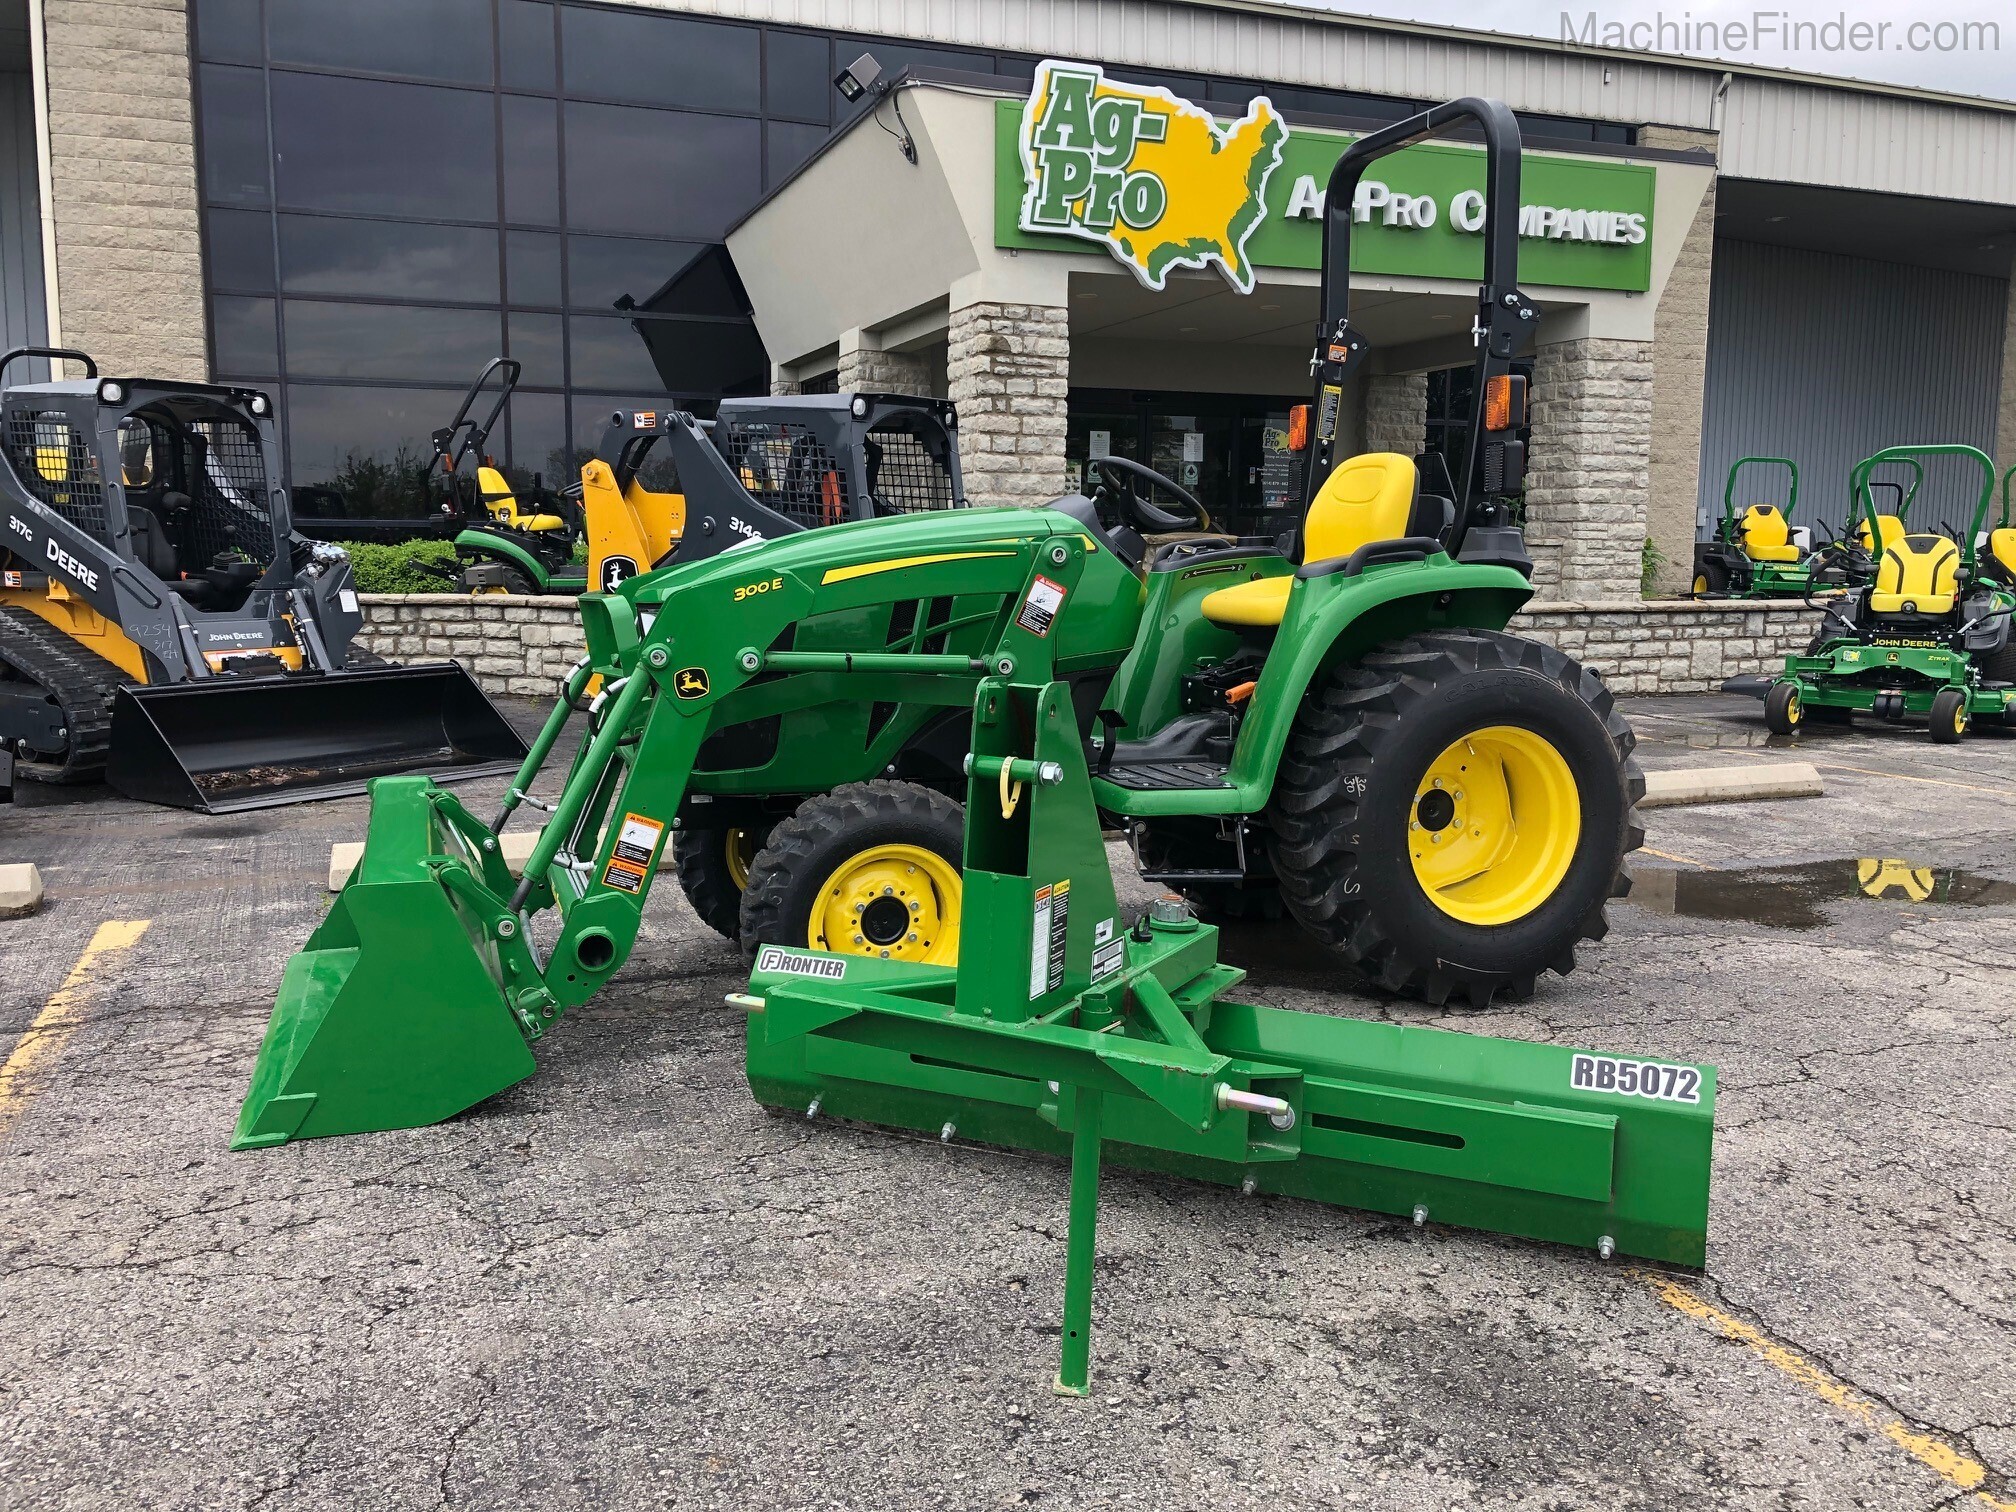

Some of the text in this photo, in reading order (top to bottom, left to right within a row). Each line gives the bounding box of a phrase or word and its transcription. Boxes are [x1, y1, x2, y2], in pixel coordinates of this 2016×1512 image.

[1034, 70, 1167, 169] Ag-
[1033, 149, 1167, 231] Pro
[1450, 189, 1646, 245] CMPANIES
[9, 515, 33, 542] 317G
[46, 537, 99, 592] DEERE
[734, 577, 783, 602] 300 E
[129, 623, 171, 638] 9254
[208, 633, 233, 641] JOHN
[1873, 638, 1937, 647] JOHN DEERE
[760, 949, 845, 977] FRONTIER
[1574, 1057, 1698, 1100] RB5072
